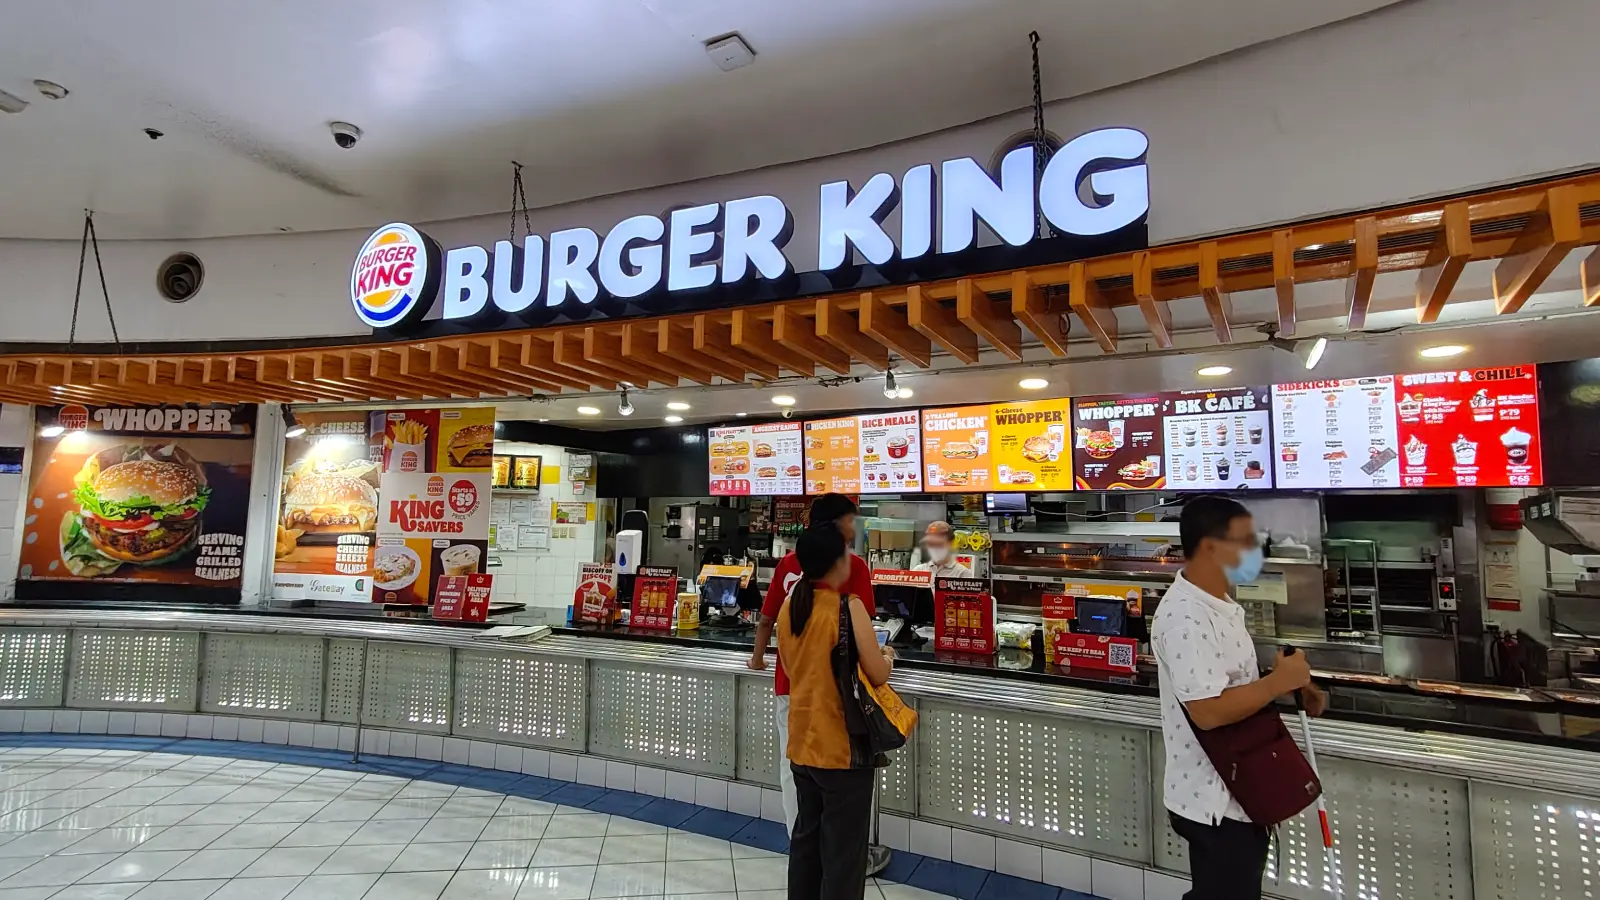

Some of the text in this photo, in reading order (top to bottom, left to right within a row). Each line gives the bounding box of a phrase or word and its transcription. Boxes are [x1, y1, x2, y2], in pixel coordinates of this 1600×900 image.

[442, 127, 1149, 320] BURGER KING
[359, 246, 417, 272] BURGER
[356, 262, 414, 298] KING
[1402, 371, 1457, 387] SWEET
[1458, 371, 1473, 382] &
[1474, 368, 1526, 381] CHILL
[1277, 379, 1340, 391] SIDEKICKS
[1174, 390, 1256, 414] BK CAFÉ
[995, 410, 1062, 425] WHOPPER
[1078, 404, 1156, 420] WHOPPER
[94, 408, 232, 432] WHOPPER
[862, 416, 916, 428] RICE MEALS
[925, 417, 984, 431] CHICKEN
[308, 422, 365, 434] 4-CHEESE
[389, 500, 444, 532] KING
[468, 500, 480, 518] VARIES
[417, 521, 463, 533] SAVERS
[198, 533, 244, 546] SERVING
[337, 534, 370, 544] SERVING
[201, 546, 241, 555] FLAME-
[196, 556, 241, 566] GRILLED
[195, 566, 240, 580] REALNESS
[335, 563, 367, 574] REALNESS
[874, 574, 908, 582] PRIORITY
[947, 581, 963, 590] KING
